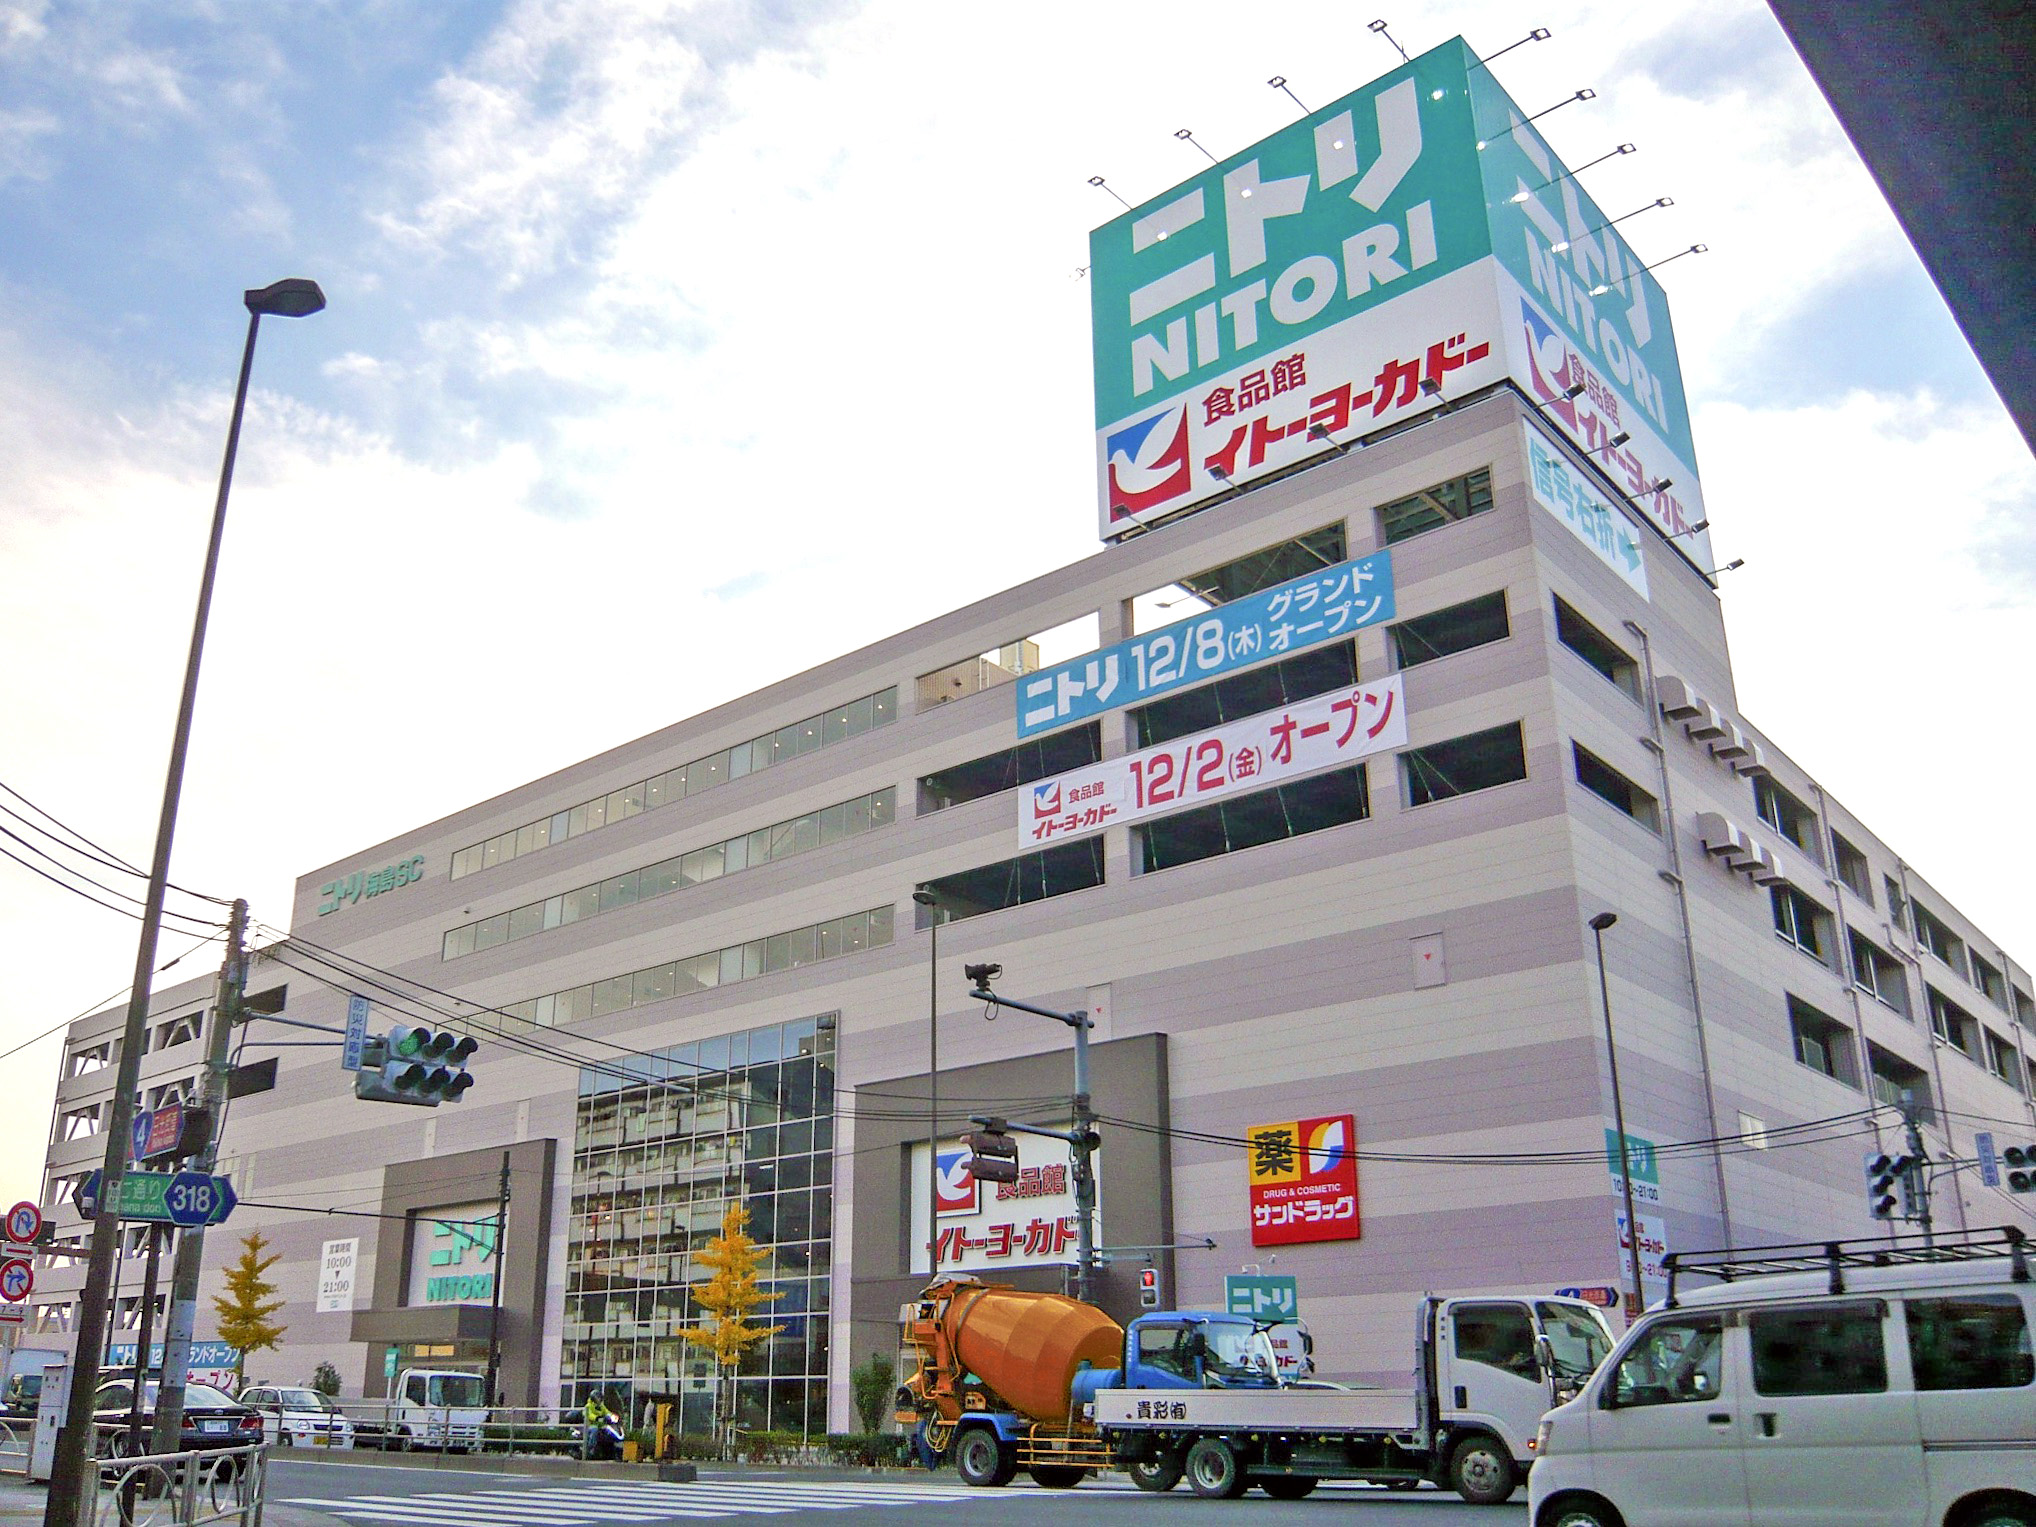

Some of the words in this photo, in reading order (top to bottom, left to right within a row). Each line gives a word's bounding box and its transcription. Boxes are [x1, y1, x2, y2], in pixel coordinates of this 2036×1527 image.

[1130, 76, 1422, 327] ニトリ
[1508, 108, 1651, 348] ニトリ
[1131, 199, 1438, 398] NITORI
[1524, 226, 1669, 434] NITORI
[1202, 352, 1306, 428] 食品館
[1204, 332, 1490, 477] イトーヨーカドー
[1568, 352, 1620, 429] 食品館
[1529, 437, 1616, 562] 信号右折
[1577, 410, 1694, 540] イトーヨーカドー
[1025, 654, 1119, 727] ニトリ
[1132, 618, 1262, 691] 12/8(木)
[1268, 562, 1374, 622] グランド
[1269, 595, 1382, 650] オープン
[1032, 802, 1117, 840] イトーヨーカドー
[1130, 738, 1262, 809] 12/2(金)
[1270, 690, 1394, 764] オープン
[1068, 780, 1104, 804] 食品館
[136, 1118, 146, 1147] 4
[1254, 1129, 1294, 1176] 薬
[1626, 1142, 1647, 1173] トリ
[173, 1184, 211, 1213] 318
[1253, 1195, 1354, 1226] サンドラッグ
[1263, 1188, 1287, 1199] DRUG
[1288, 1187, 1295, 1197] &
[1297, 1183, 1341, 1196] COSMETIC
[326, 1256, 351, 1269] 10:00
[429, 1215, 497, 1266] ニトリ
[926, 1215, 1080, 1263] イトーヨーカド
[323, 1280, 349, 1293] 21:00
[426, 1273, 493, 1301] NITORI
[1232, 1287, 1293, 1313] ニトリ
